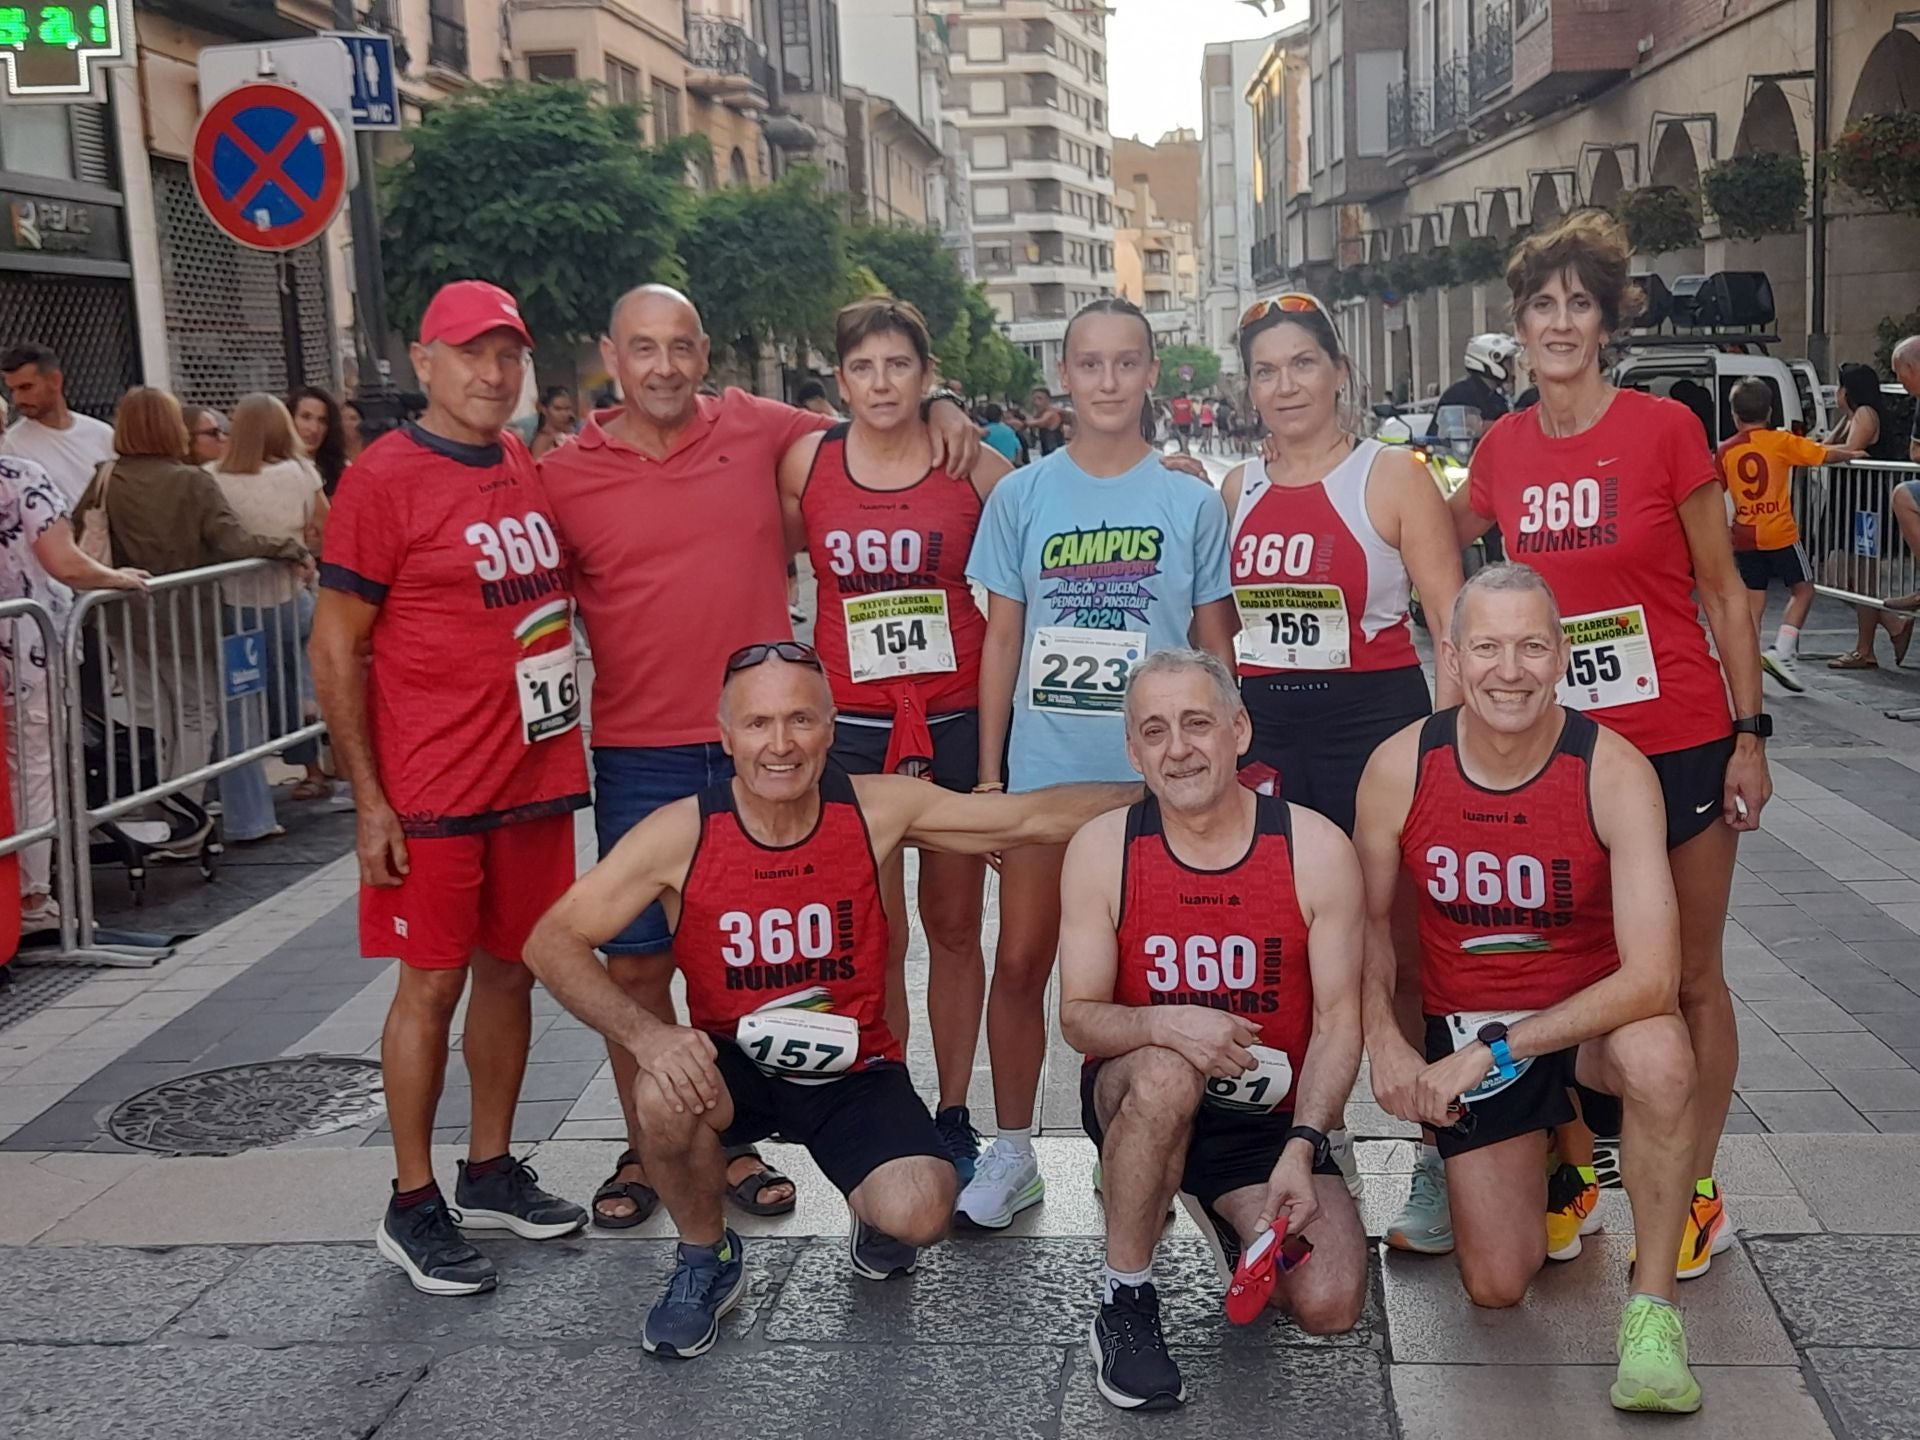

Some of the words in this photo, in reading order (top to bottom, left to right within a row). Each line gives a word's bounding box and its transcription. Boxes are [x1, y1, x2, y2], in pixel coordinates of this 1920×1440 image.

[367, 103, 392, 122] WC
[1737, 451, 1769, 501] 9
[1520, 478, 1600, 533] 360
[1604, 476, 1617, 520] RIOJA
[464, 511, 561, 581] 360
[825, 529, 922, 576] 360
[925, 531, 943, 572] RIOJA
[1043, 529, 1159, 569] CAMPUS
[1235, 533, 1315, 578] 360
[1516, 524, 1617, 553] RUNNERS
[892, 595, 929, 606] CARRERA
[1052, 596, 1092, 608] PEDROLA
[1102, 596, 1149, 608] PINSEQUE
[1058, 577, 1096, 594] ALAGÓN
[1106, 582, 1138, 594] LUCENI
[1240, 600, 1271, 609] CIUDAD
[1273, 599, 1284, 607] DE
[1285, 590, 1323, 599] CARRERA
[850, 612, 877, 623] CIUDAD
[878, 609, 888, 617] DE
[1075, 608, 1122, 628] 2024
[1265, 612, 1320, 647] 156
[870, 619, 928, 656] 154
[1041, 653, 1129, 693] 223
[1463, 808, 1508, 824] luanvi
[754, 864, 799, 880] luanvi
[1425, 845, 1546, 909] 360
[1551, 858, 1573, 909] RIOJA
[1180, 893, 1224, 906] luanvi
[719, 903, 833, 967] 360
[836, 899, 854, 951] RIOJA
[726, 956, 856, 990] RUNNERS
[1144, 935, 1257, 992] 360
[1263, 937, 1282, 987] RIOJA
[750, 1035, 845, 1070] 157
